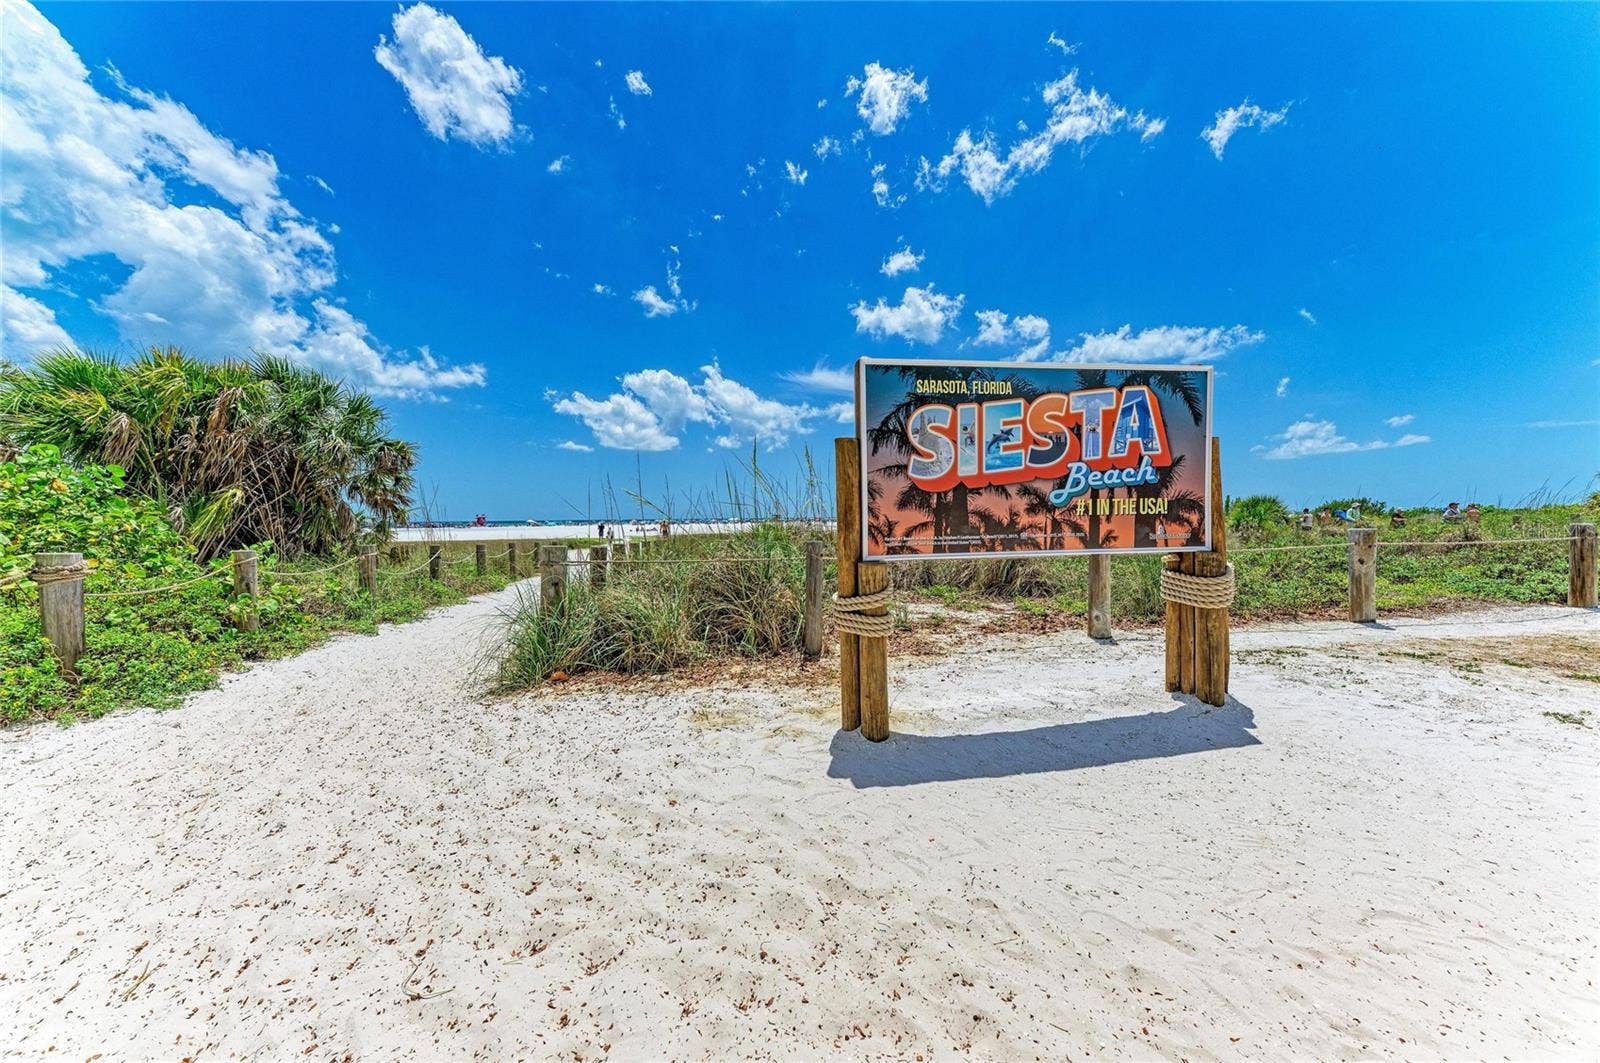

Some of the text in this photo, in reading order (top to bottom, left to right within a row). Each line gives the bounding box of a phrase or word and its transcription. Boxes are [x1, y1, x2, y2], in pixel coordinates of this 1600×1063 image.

[916, 379, 1012, 395] SARASOTA, FLORIDA
[907, 385, 1169, 488] SIESTA
[1050, 456, 1158, 507] Beach
[1076, 497, 1168, 516] #1 IN THE USA!
